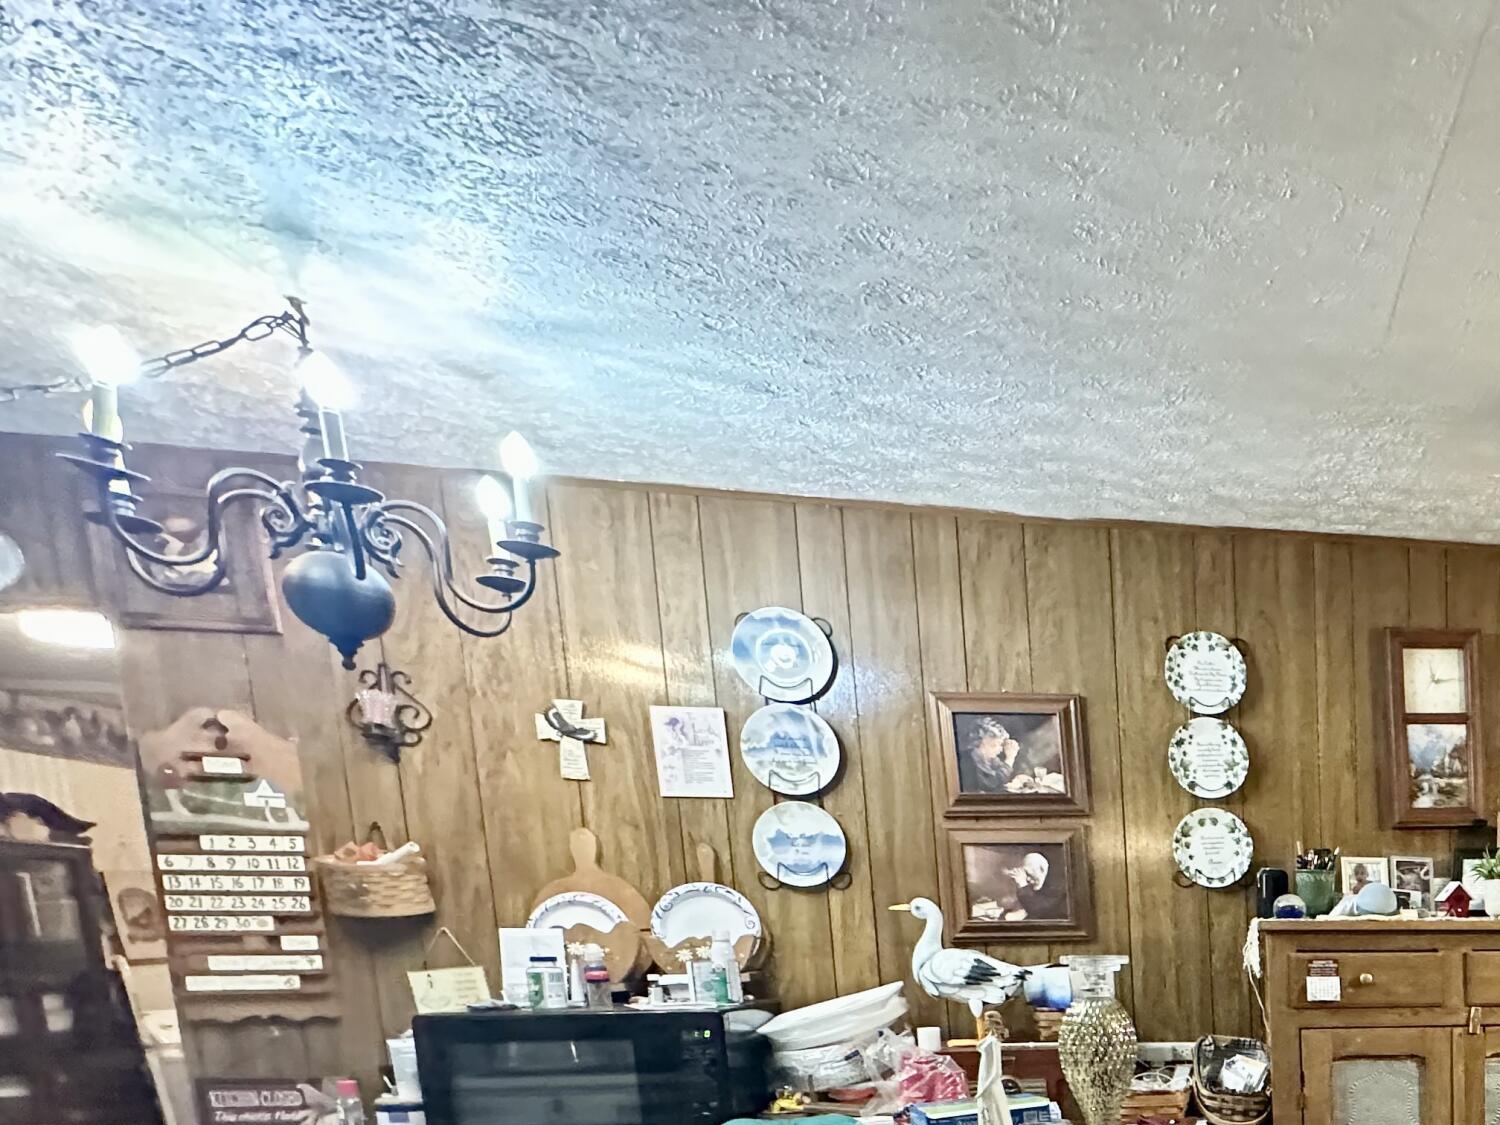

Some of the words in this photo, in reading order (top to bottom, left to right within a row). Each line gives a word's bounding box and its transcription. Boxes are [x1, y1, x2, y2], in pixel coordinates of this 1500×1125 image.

[208, 838, 215, 849] 1
[228, 838, 237, 849] 2
[247, 838, 256, 849] 3
[268, 838, 277, 849] 4
[289, 838, 297, 849] 5
[164, 857, 173, 867] 6
[185, 857, 194, 868] 7
[206, 857, 216, 868] 8
[226, 857, 236, 869] 9
[247, 857, 260, 869] 10
[267, 857, 280, 869] 11
[287, 857, 300, 869] 12
[167, 876, 181, 888] 13
[189, 877, 200, 888] 14
[210, 877, 224, 889] 15
[231, 878, 244, 889] 16
[252, 877, 265, 889] 17
[272, 878, 283, 889] 18
[294, 878, 305, 889] 19
[169, 897, 183, 907] 20
[189, 897, 202, 907] 21
[210, 898, 223, 909] 22
[231, 898, 246, 909] 23
[251, 898, 265, 909] 24
[272, 898, 286, 909] 25
[291, 898, 306, 909] 26
[173, 917, 187, 928] 27
[194, 917, 208, 928] 28
[214, 917, 228, 928] 29
[236, 917, 251, 928] 30
